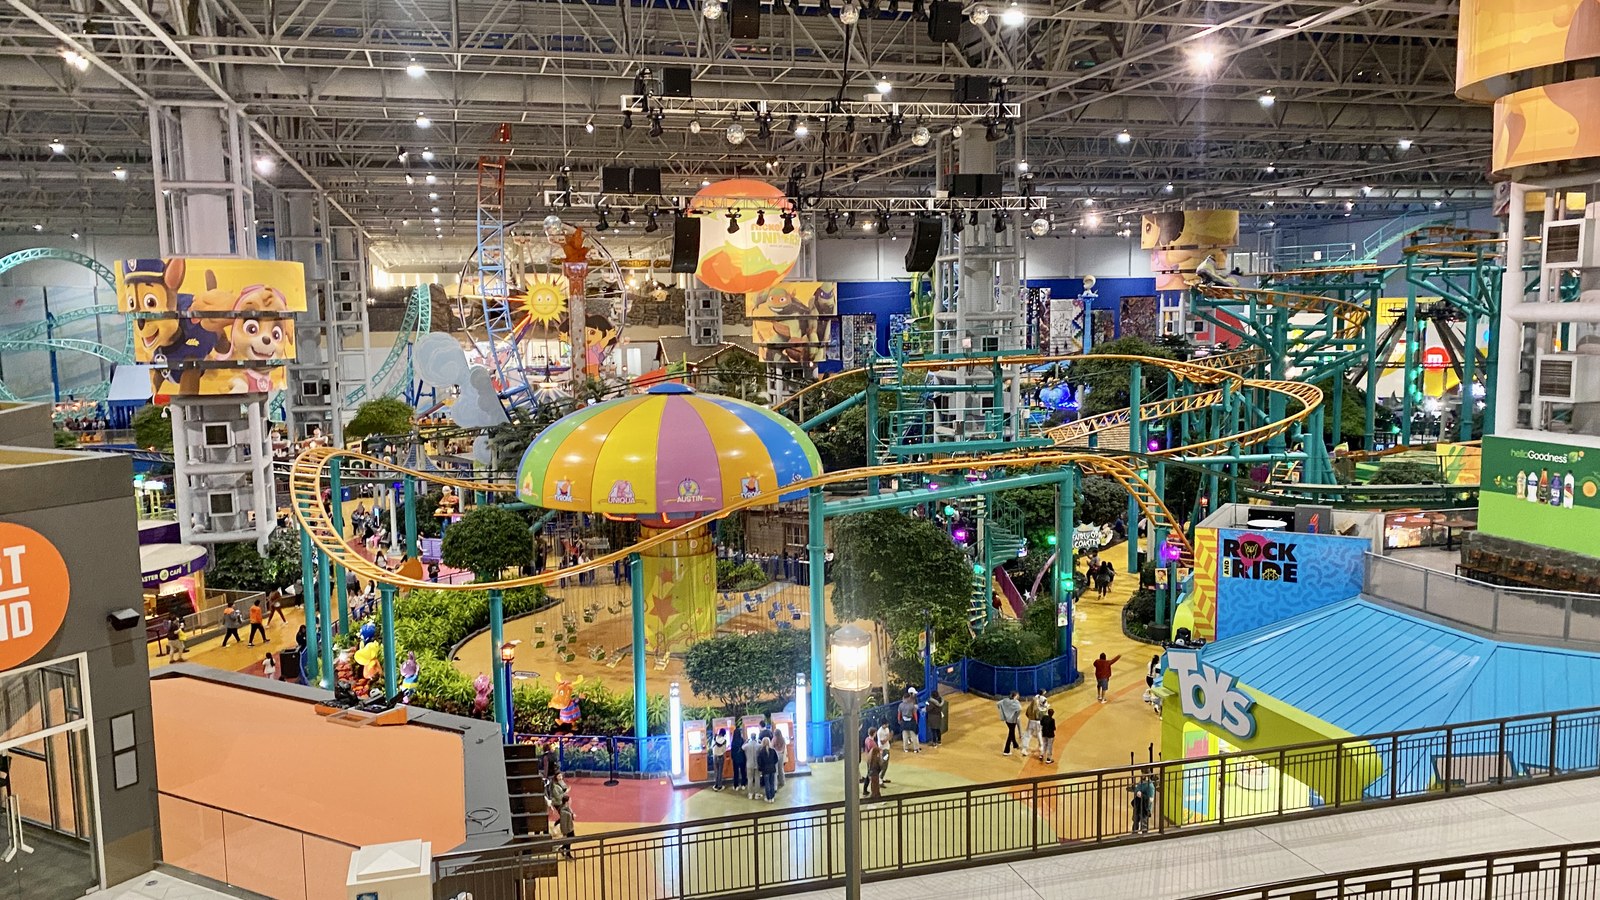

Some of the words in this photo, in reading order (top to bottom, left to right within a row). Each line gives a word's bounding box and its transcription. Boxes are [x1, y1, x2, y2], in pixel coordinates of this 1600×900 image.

[608, 496, 636, 504] UNIQUA
[677, 495, 703, 503] AUSTIN
[1223, 538, 1298, 563] ROCK
[0, 544, 26, 585] T
[1232, 560, 1298, 583] RIDE
